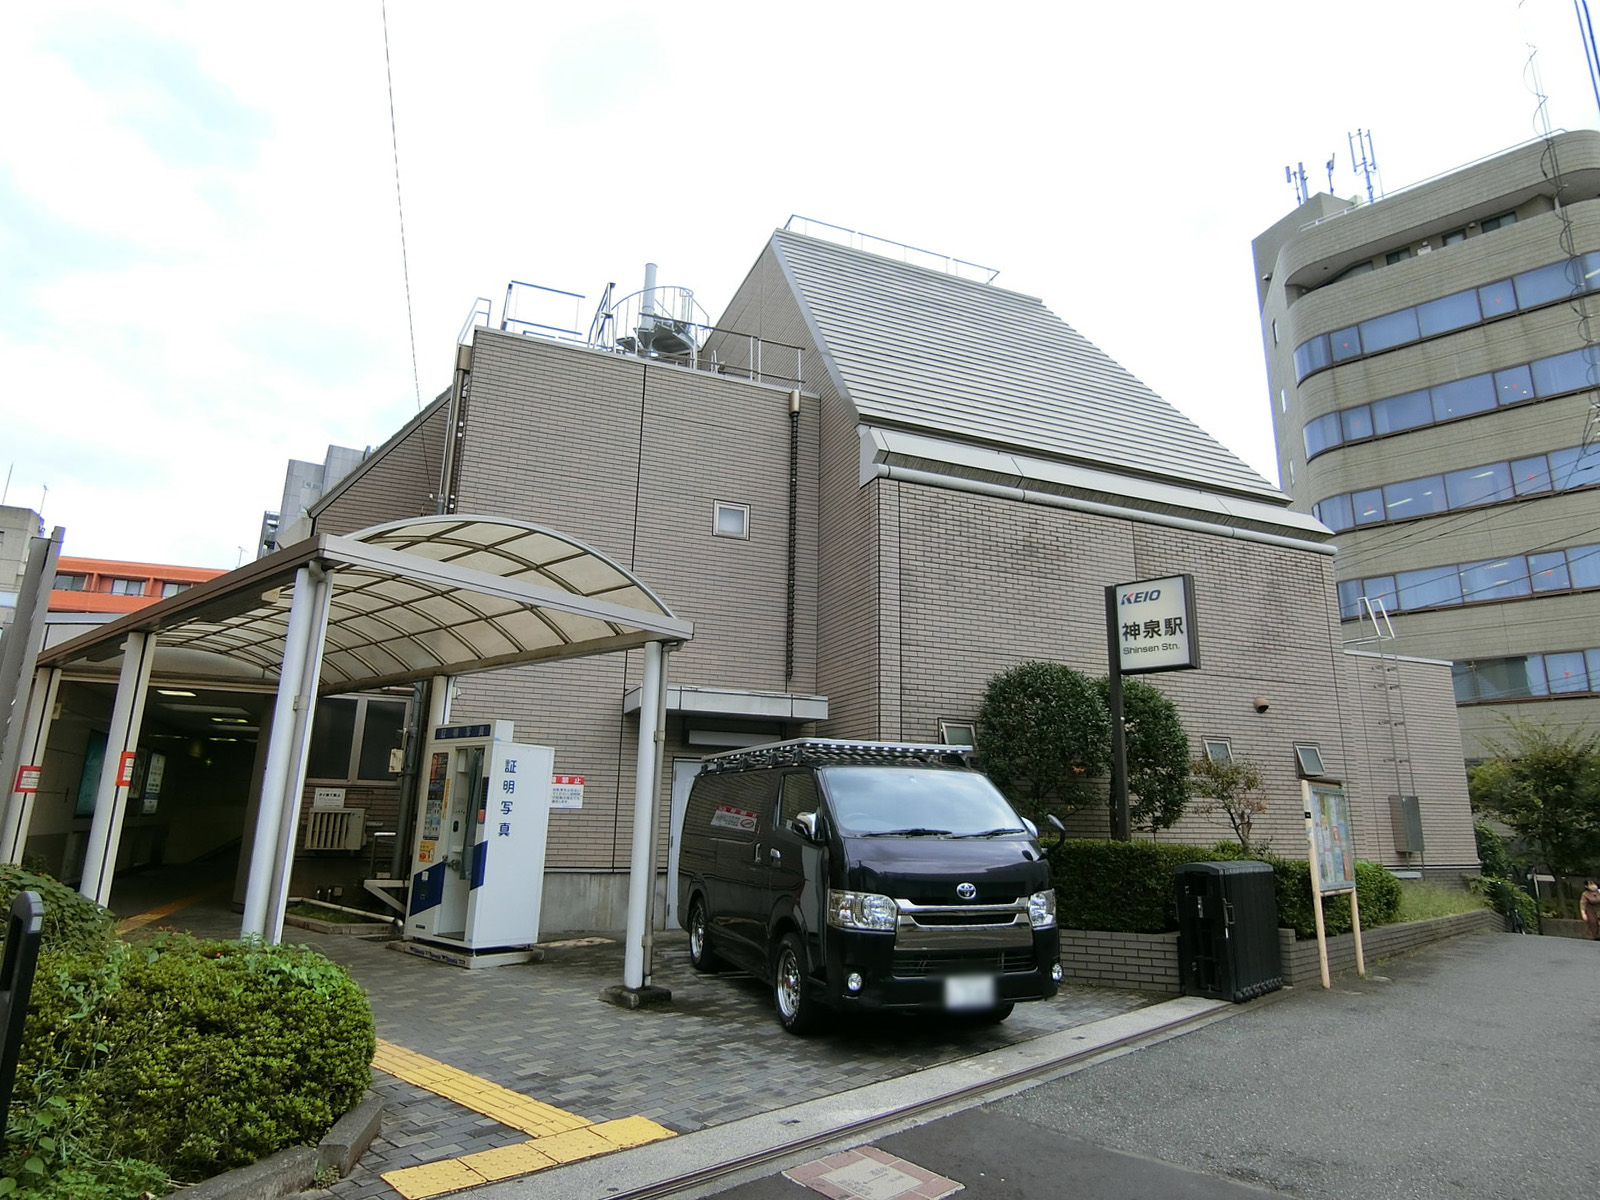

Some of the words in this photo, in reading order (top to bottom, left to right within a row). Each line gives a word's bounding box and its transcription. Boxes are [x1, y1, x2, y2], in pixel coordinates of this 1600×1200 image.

[1121, 590, 1161, 605] KEIO
[1121, 617, 1184, 641] 神泉駅
[1123, 645, 1160, 655] Shinsen
[498, 759, 517, 837] 証明写真
